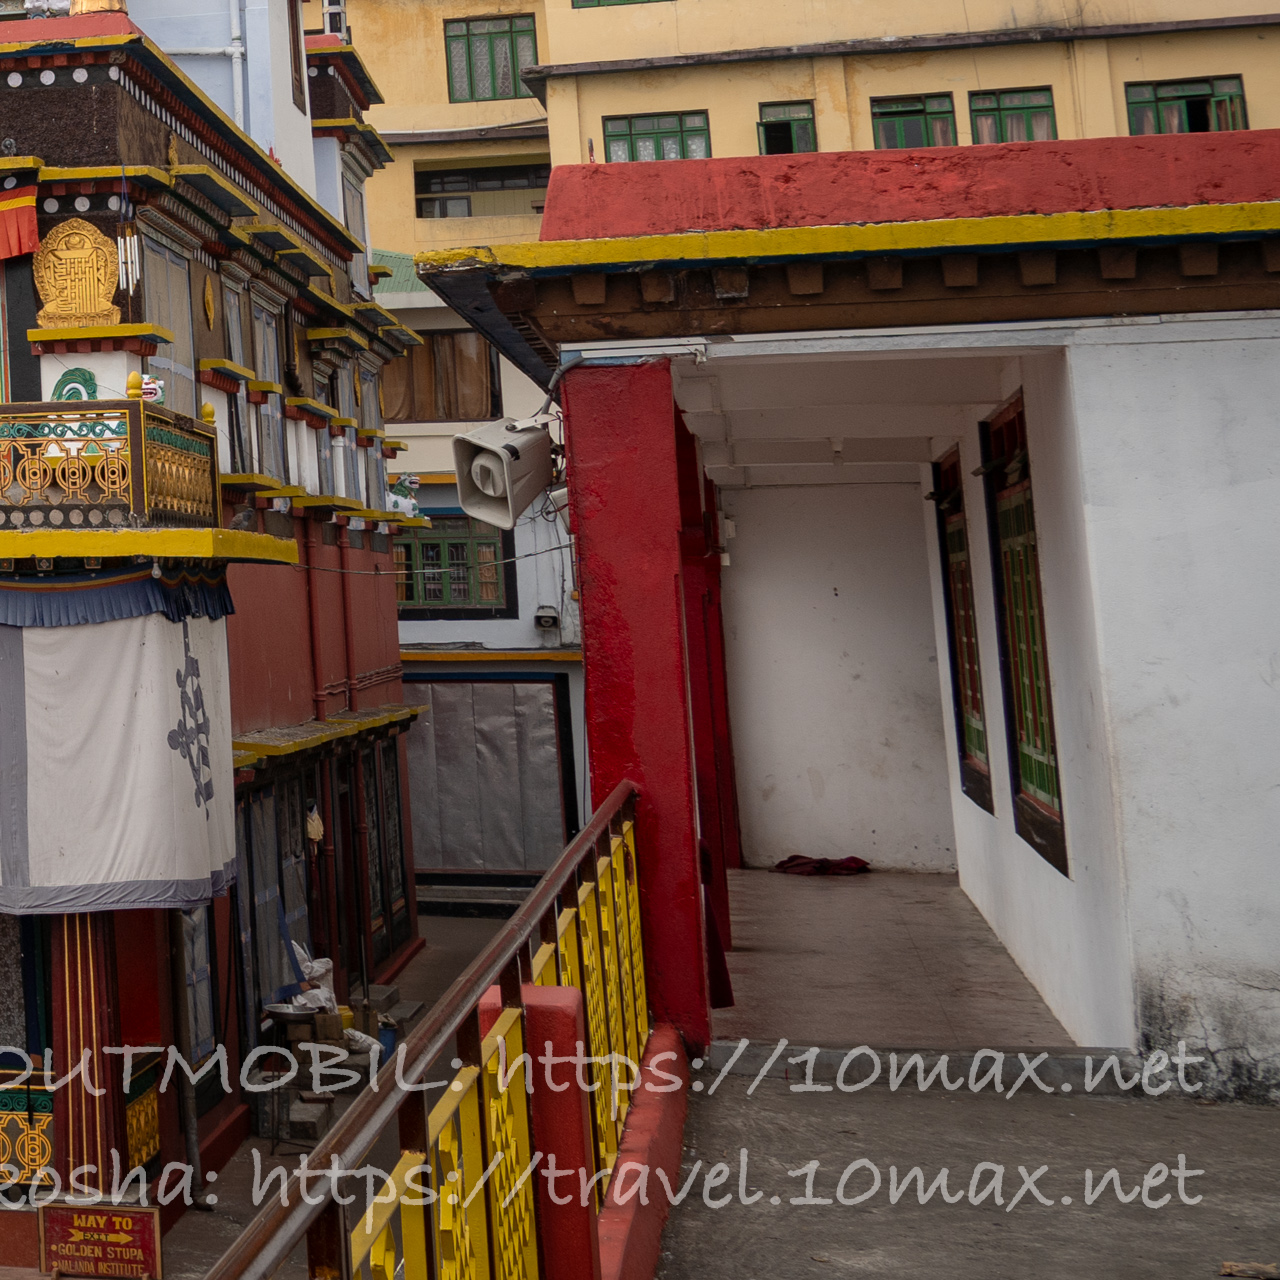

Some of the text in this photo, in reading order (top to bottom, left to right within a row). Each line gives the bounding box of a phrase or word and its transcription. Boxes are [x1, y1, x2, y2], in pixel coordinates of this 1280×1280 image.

[73, 1214, 133, 1231] WAY TO
[83, 1231, 110, 1242] EXIT
[57, 1243, 144, 1261] GOLDEN STUPA
[57, 1260, 145, 1277] NALANDA INSTITUTE
